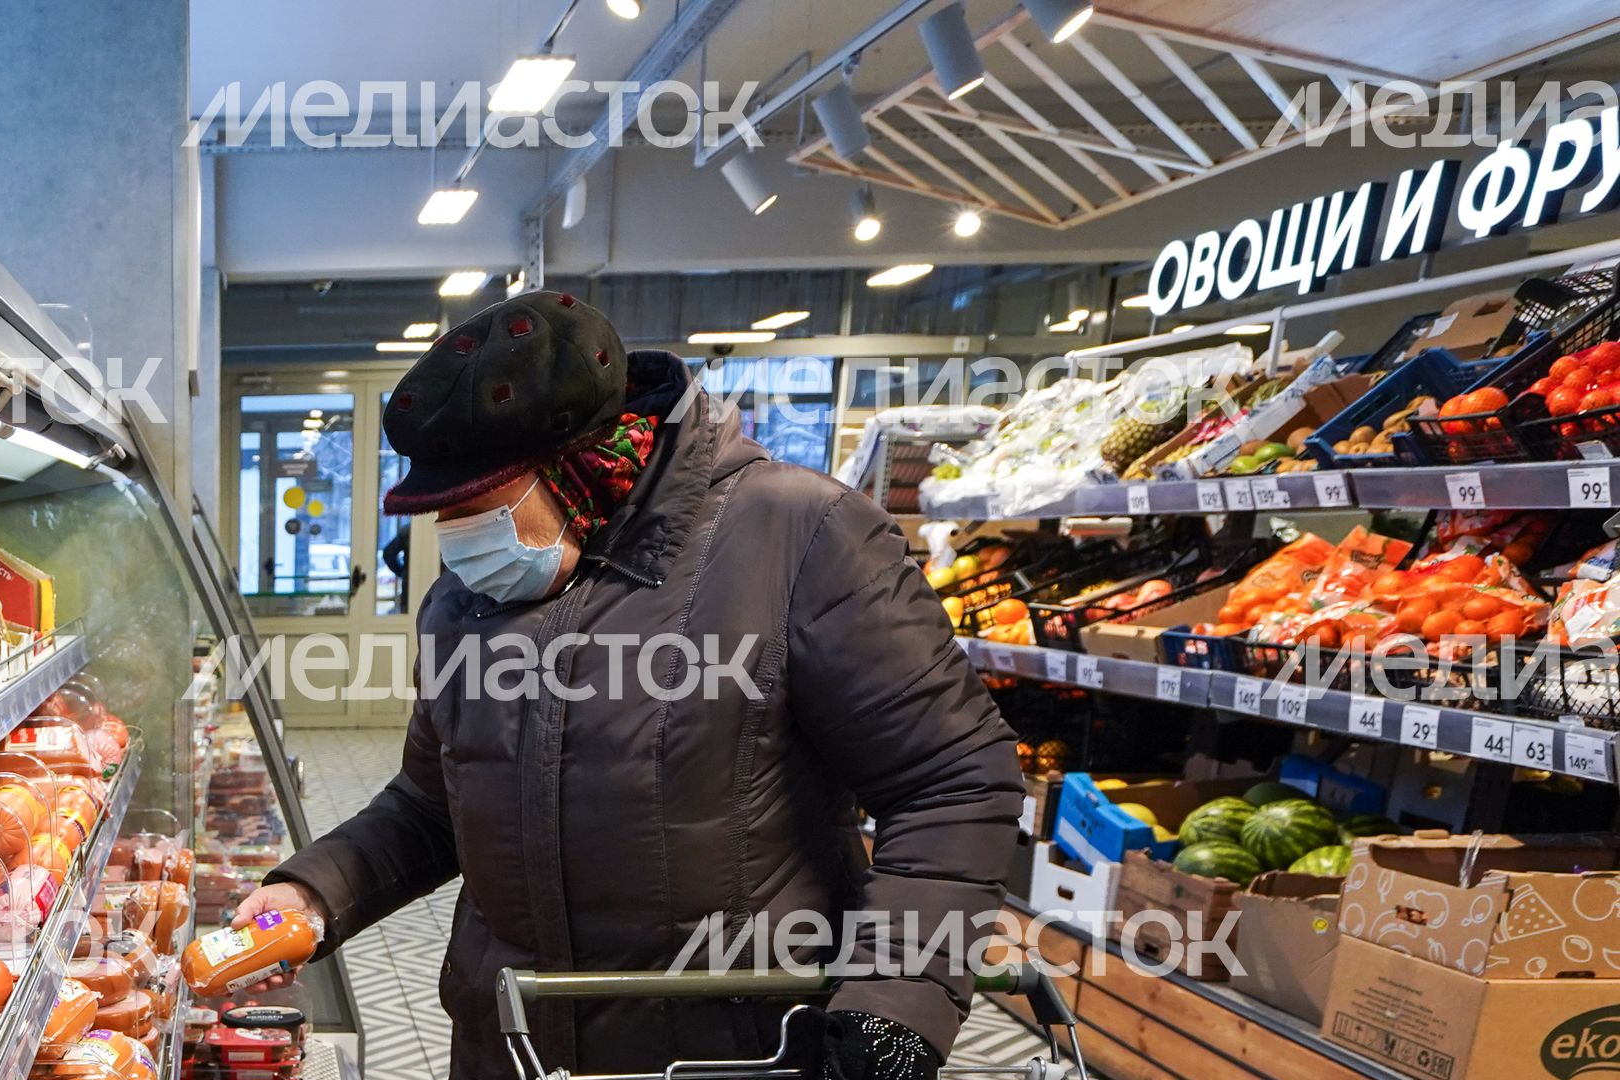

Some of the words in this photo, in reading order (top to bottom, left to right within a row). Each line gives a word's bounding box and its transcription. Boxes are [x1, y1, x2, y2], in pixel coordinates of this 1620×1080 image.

[1147, 181, 1372, 317] ОВОЩИ
[1381, 159, 1446, 262] И
[1325, 486, 1341, 500] 99
[1459, 486, 1477, 502] 99
[1581, 482, 1603, 500] 99
[1281, 698, 1301, 716] 109
[1359, 711, 1376, 729] 44
[1412, 722, 1430, 741] 29
[1484, 734, 1504, 754] 44
[1526, 742, 1546, 761] 63
[1568, 754, 1588, 771] 149
